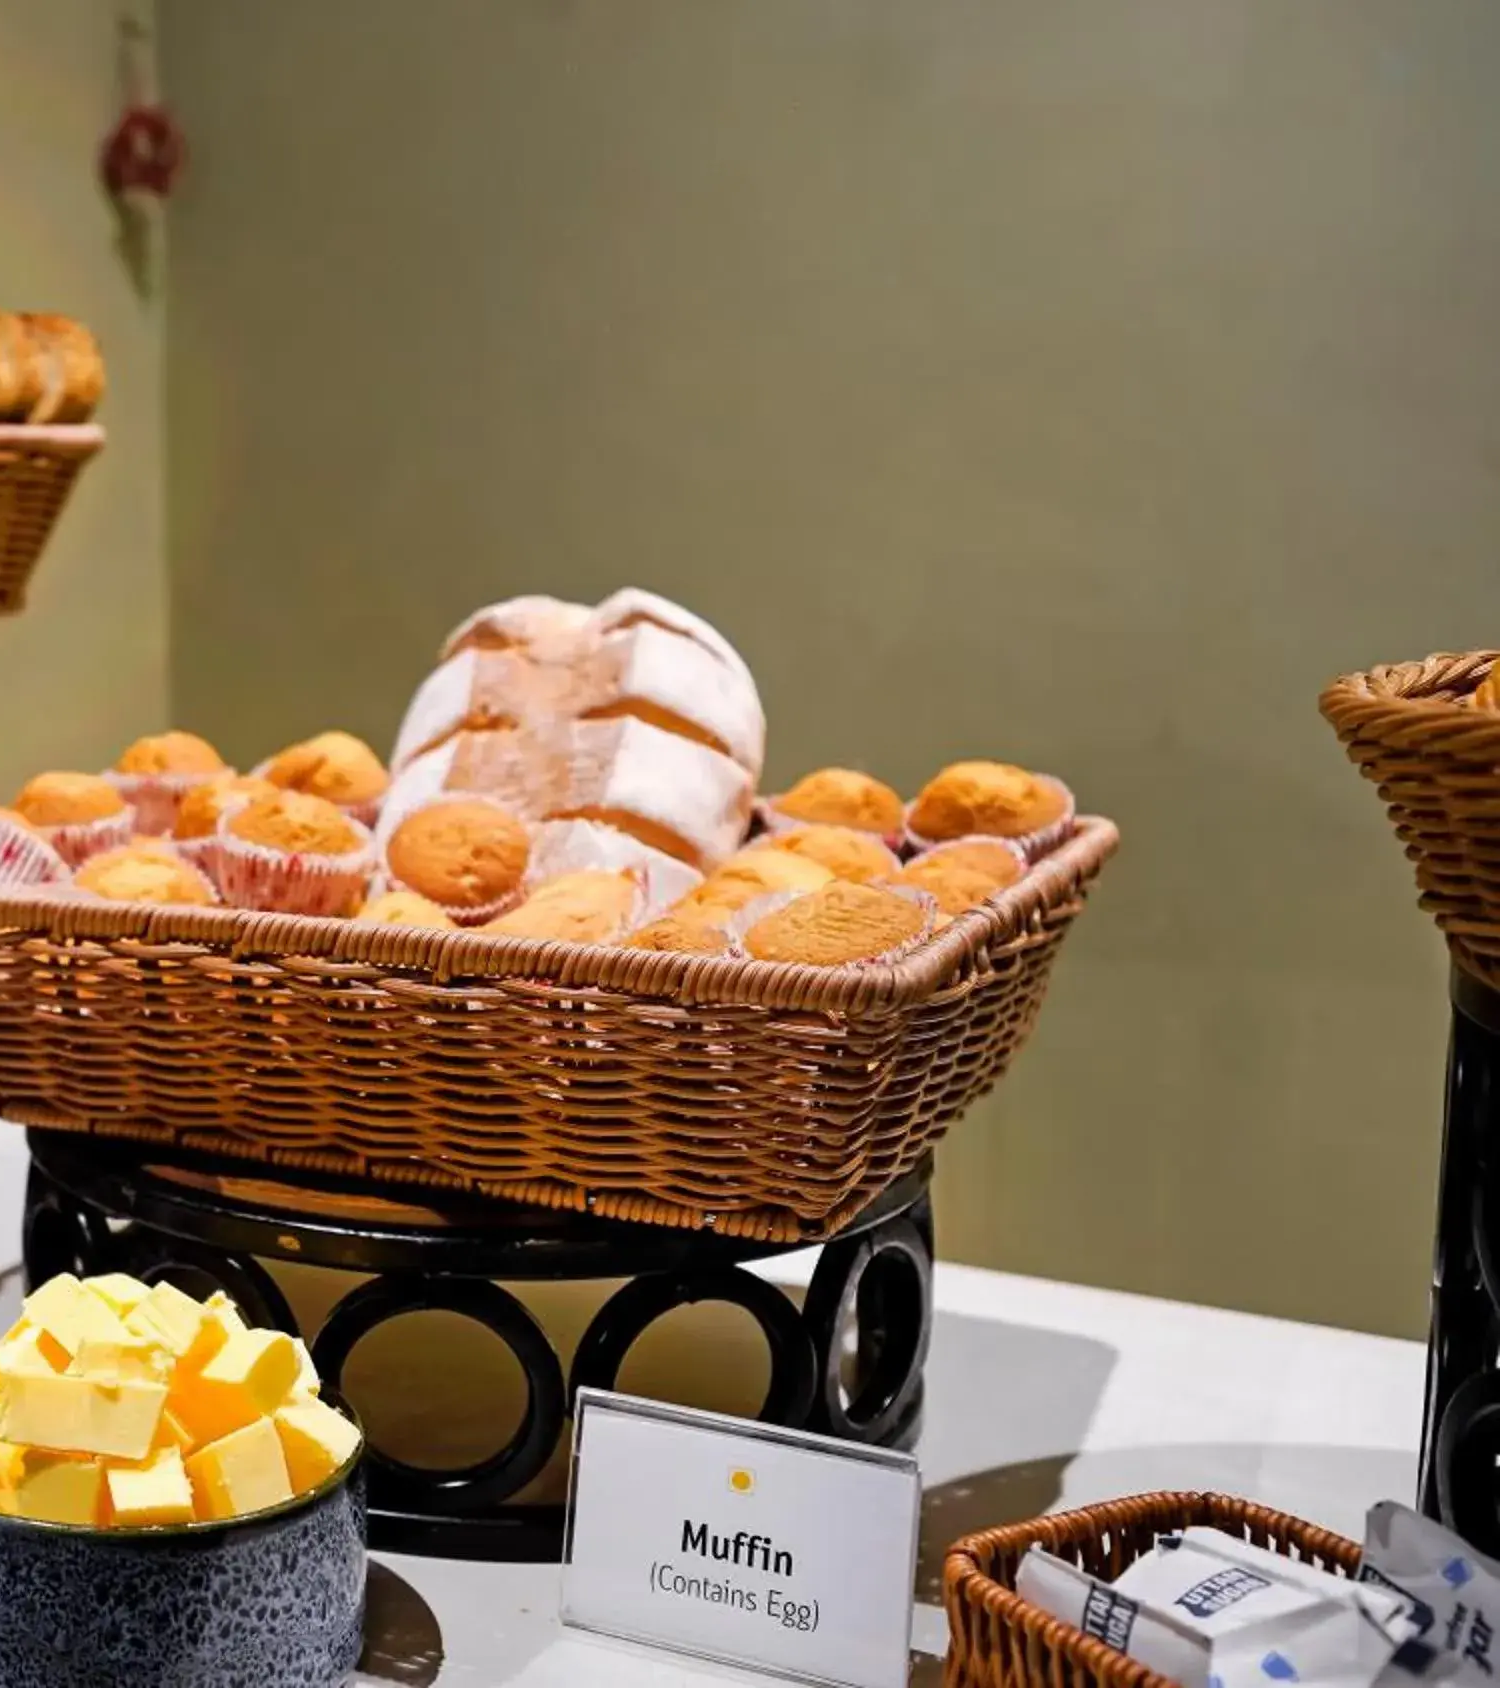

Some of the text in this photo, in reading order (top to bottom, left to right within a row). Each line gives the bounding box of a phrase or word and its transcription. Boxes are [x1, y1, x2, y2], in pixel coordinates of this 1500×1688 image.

[680, 1519, 793, 1577] Muffin
[650, 1561, 820, 1633] (Contains Egg)
